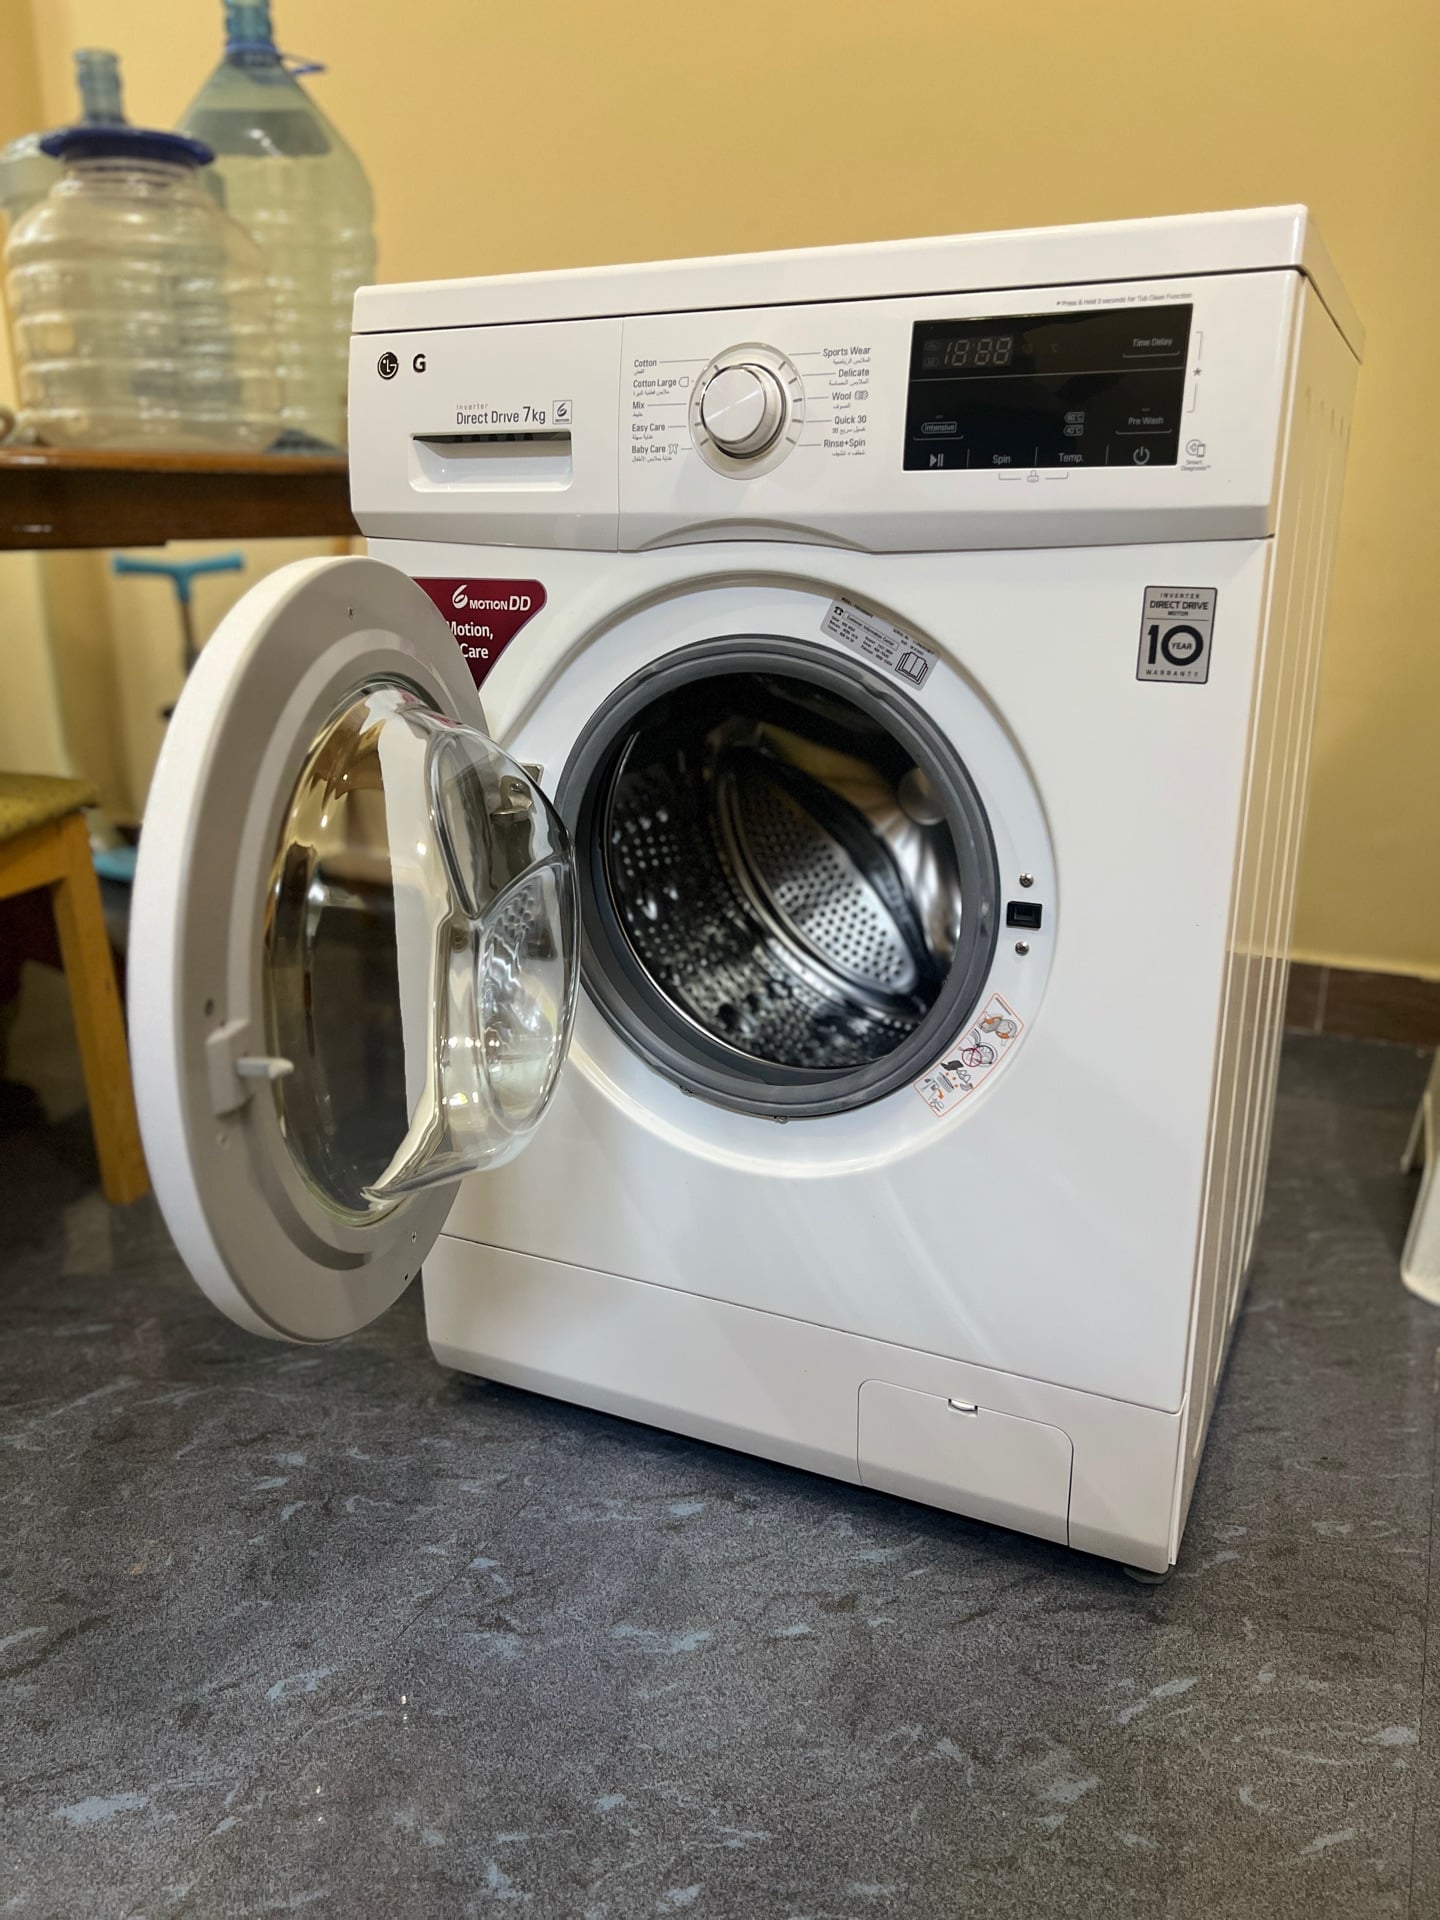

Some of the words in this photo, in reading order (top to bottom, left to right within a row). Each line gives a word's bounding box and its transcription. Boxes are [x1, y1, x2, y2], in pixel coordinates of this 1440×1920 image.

[1133, 338, 1150, 347] Time
[1152, 338, 1172, 348] Delay
[823, 348, 848, 358] Sports
[850, 346, 871, 355] Wear
[412, 354, 426, 373] G
[634, 360, 657, 368] Cotton
[838, 368, 870, 378] Delicate
[633, 380, 656, 388] Cotton
[657, 378, 676, 388] Large
[832, 392, 852, 400] Wool
[632, 402, 645, 410] Mix
[456, 412, 488, 424] Direct
[492, 410, 520, 424] Drive
[834, 416, 856, 425] Quick
[858, 415, 867, 424] 30
[1128, 417, 1140, 425] Pre
[1142, 416, 1164, 424] Wash
[632, 424, 648, 433] Easy
[650, 423, 666, 432] Care
[924, 422, 955, 432] Intensive
[824, 439, 866, 448] Rinse+Spin
[632, 445, 648, 454] Baby
[650, 444, 666, 453] Care
[992, 454, 1012, 465] Spin
[1058, 452, 1084, 463] Temp.
[469, 600, 508, 610] MOTION
[508, 595, 531, 611] DD
[1150, 600, 1181, 609] DIRECT
[1182, 602, 1208, 610] DRIVE
[1148, 624, 1204, 666] 10
[1171, 642, 1193, 650] YEAR
[460, 643, 489, 658] Care
[1146, 670, 1198, 678] WARRANTY
